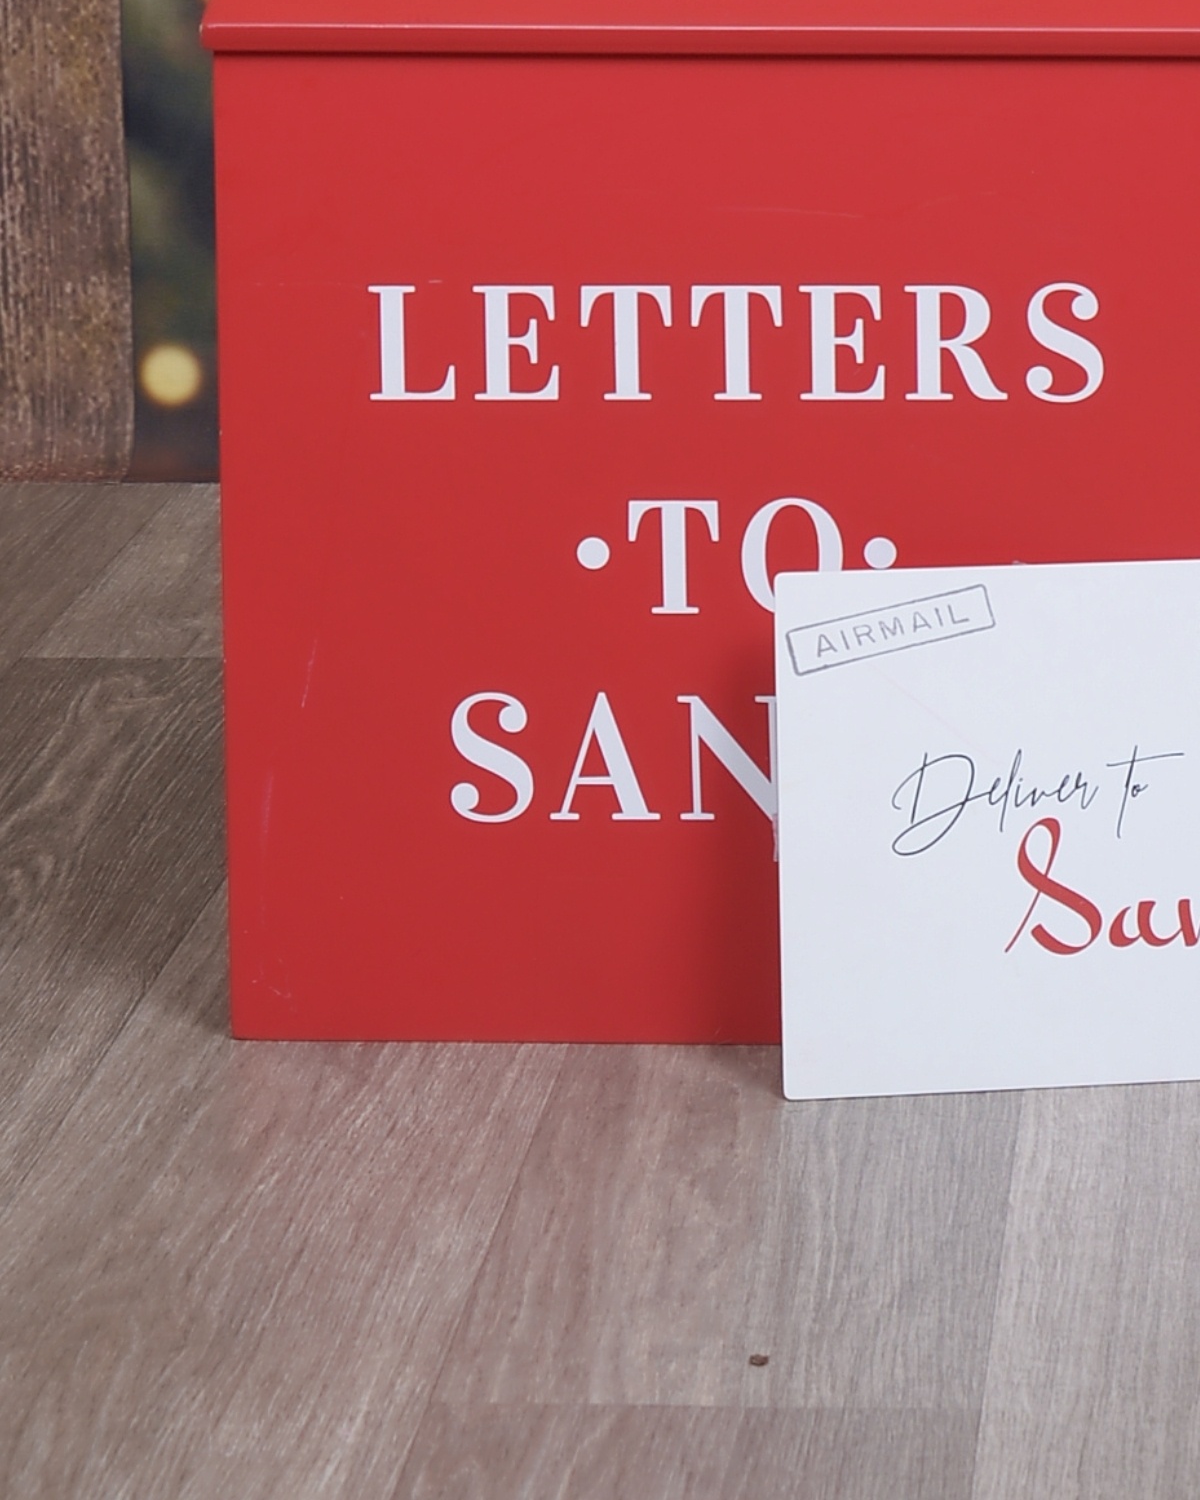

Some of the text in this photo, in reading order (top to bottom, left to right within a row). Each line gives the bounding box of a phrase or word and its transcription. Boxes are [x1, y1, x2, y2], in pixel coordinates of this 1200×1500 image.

[367, 282, 1105, 403] LETTERS
[814, 603, 971, 659] AIRMAIL
[449, 691, 777, 824] SAN
[891, 745, 1185, 857] Deliver to
